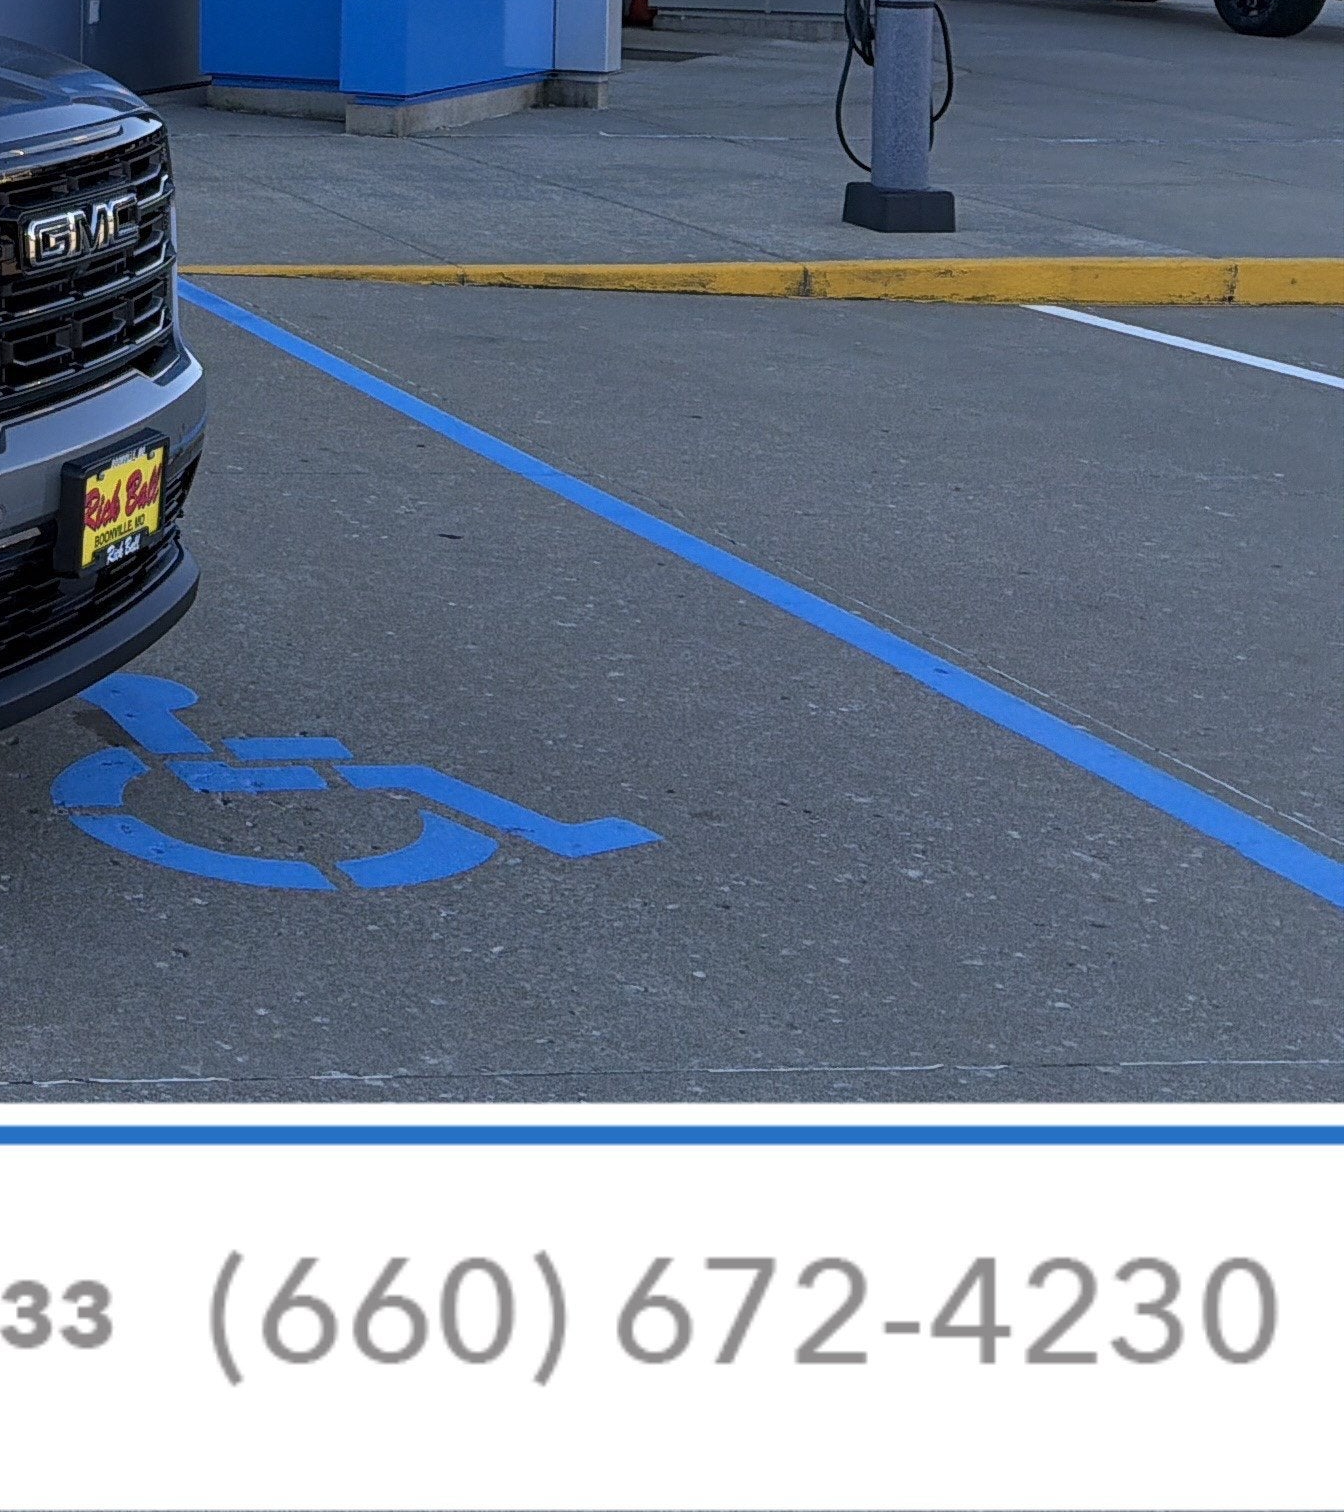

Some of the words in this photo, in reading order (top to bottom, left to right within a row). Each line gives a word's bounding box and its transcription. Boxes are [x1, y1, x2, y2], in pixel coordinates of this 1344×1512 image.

[27, 192, 140, 267] GMC
[85, 479, 121, 531] Rick
[125, 463, 162, 516] Ball
